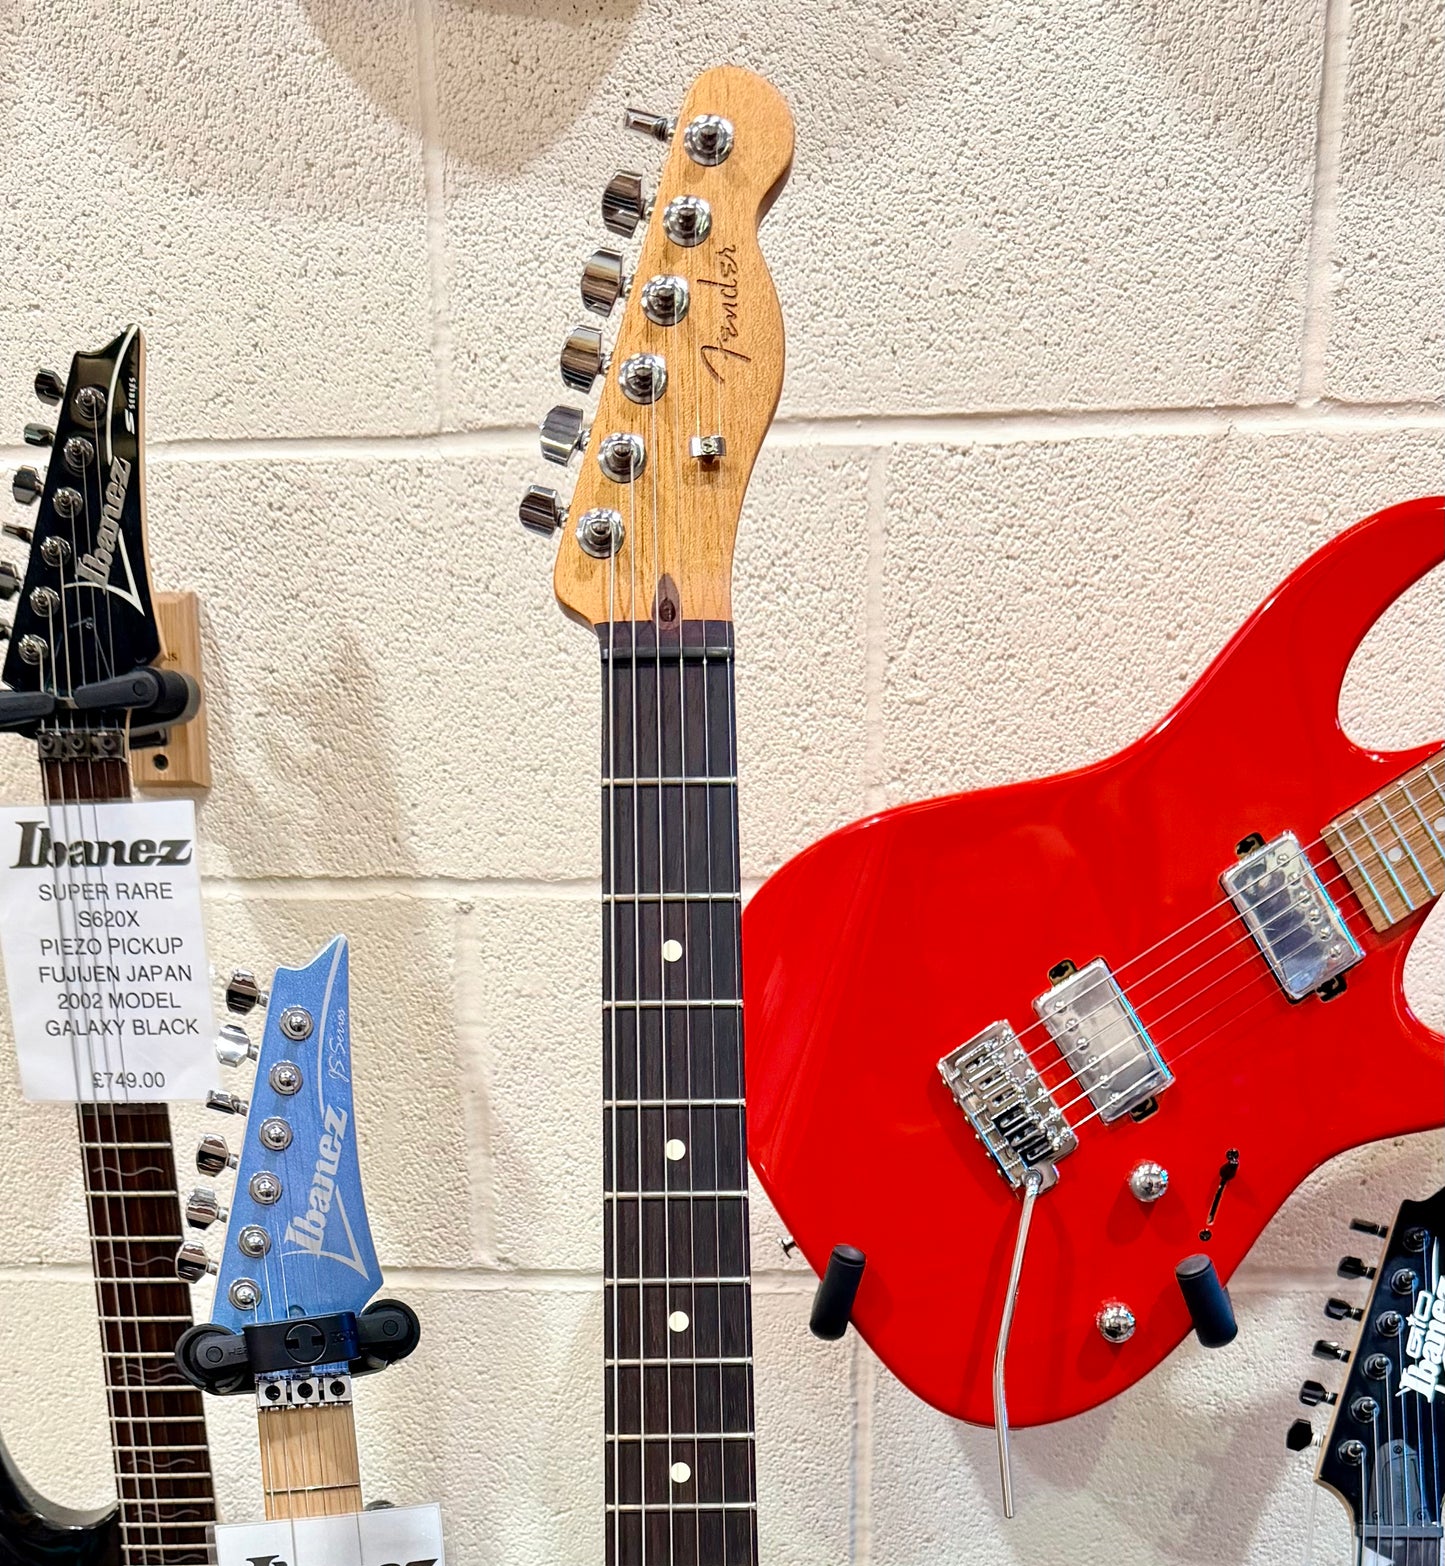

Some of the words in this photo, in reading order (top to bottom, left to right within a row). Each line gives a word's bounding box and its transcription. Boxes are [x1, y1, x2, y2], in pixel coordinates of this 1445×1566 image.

[696, 244, 751, 385] Fender
[77, 456, 131, 592] Ibanez
[9, 820, 192, 869] Ibanez
[38, 883, 110, 902] SUPER
[116, 882, 173, 900] RARE
[78, 910, 140, 928] S620X
[40, 938, 102, 956] PIEZO
[108, 937, 184, 955] PICKUP
[126, 965, 192, 982] JAPAN
[57, 992, 104, 1010] 2002
[109, 992, 181, 1009] MODEL
[45, 1020, 126, 1037] GALAXY
[132, 1018, 200, 1036] BLACK
[92, 1072, 166, 1089] £749.00
[284, 1104, 347, 1257] Ibanez
